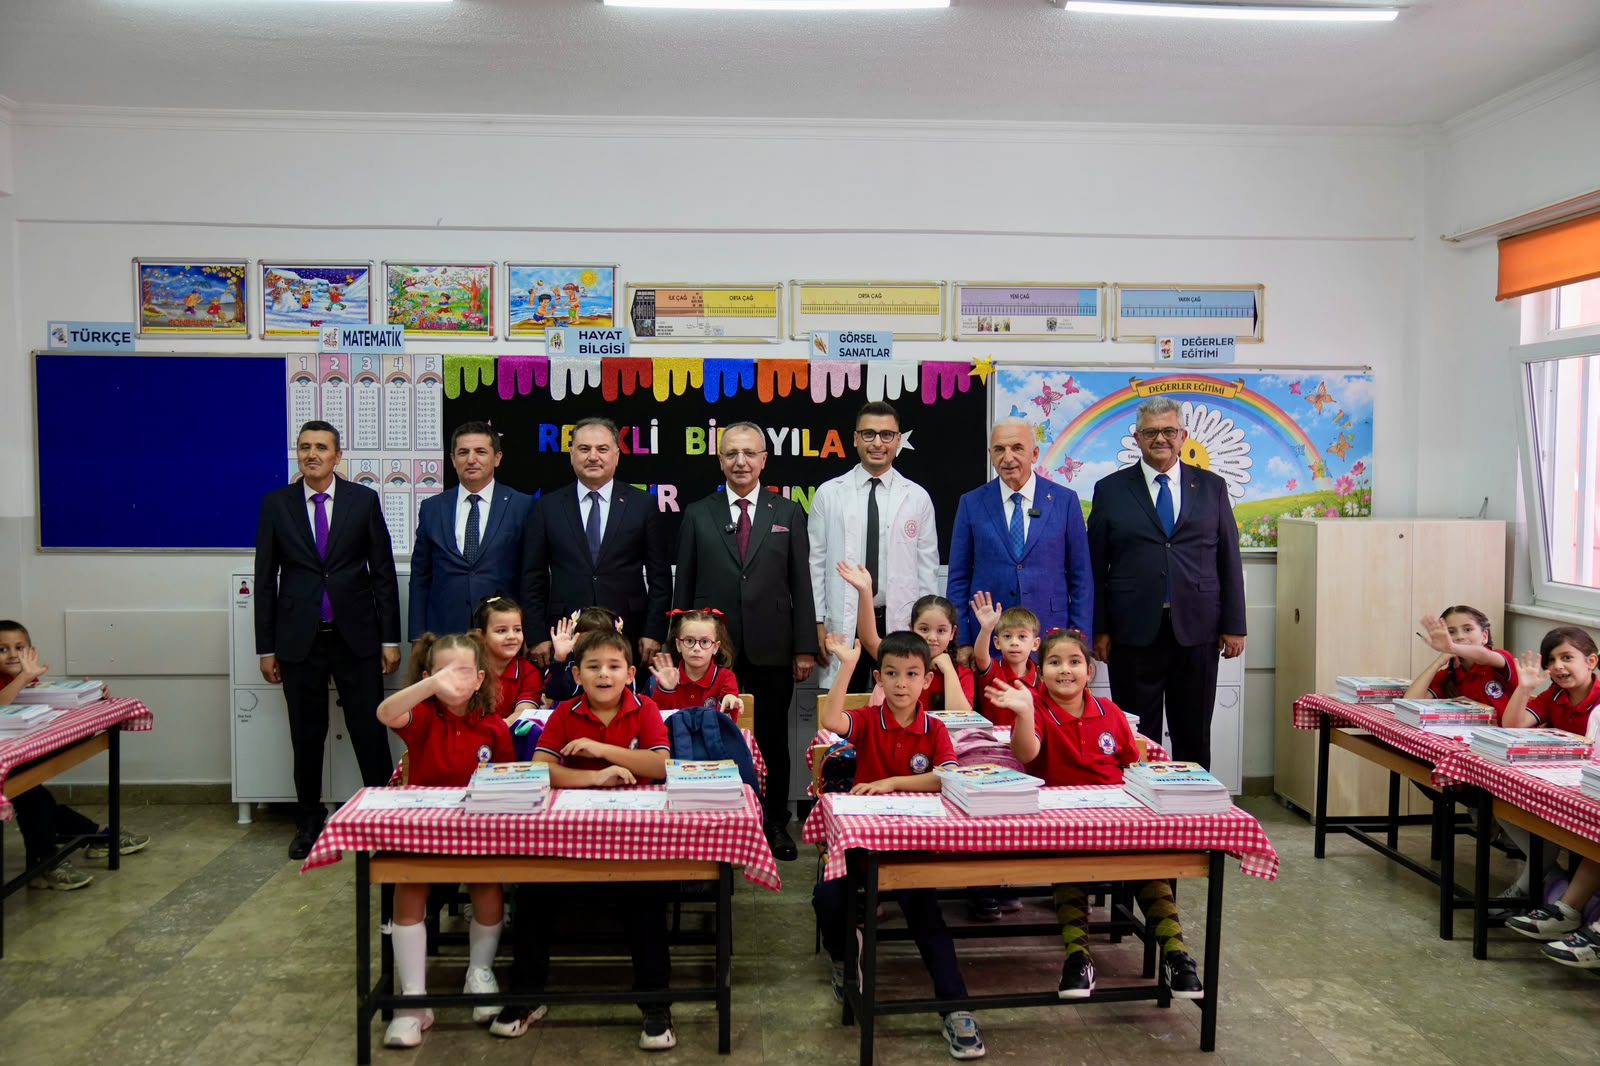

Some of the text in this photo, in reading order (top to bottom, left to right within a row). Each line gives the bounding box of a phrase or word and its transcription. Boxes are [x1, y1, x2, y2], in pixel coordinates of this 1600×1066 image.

[70, 328, 131, 346] TÜRKÇE
[343, 326, 401, 346] MATEMATİK
[579, 331, 622, 340] HAYAT
[839, 332, 878, 344] GÖRSEL
[1182, 336, 1234, 346] DEĞERLER
[579, 343, 625, 354] BİLGİSİ
[839, 348, 890, 357] SANATLAR
[1181, 348, 1218, 358] EĞİTİMİ
[299, 356, 307, 370] 1
[330, 356, 340, 370] 2
[362, 356, 372, 371] 3
[393, 356, 404, 371] 4
[425, 356, 435, 371] 5
[1149, 382, 1225, 395] DEĞERLER EĞİTİMİ
[539, 418, 846, 459] REKLİ Bİ YILA
[360, 459, 372, 472] 8
[391, 460, 402, 472] 9
[420, 461, 438, 473] 10
